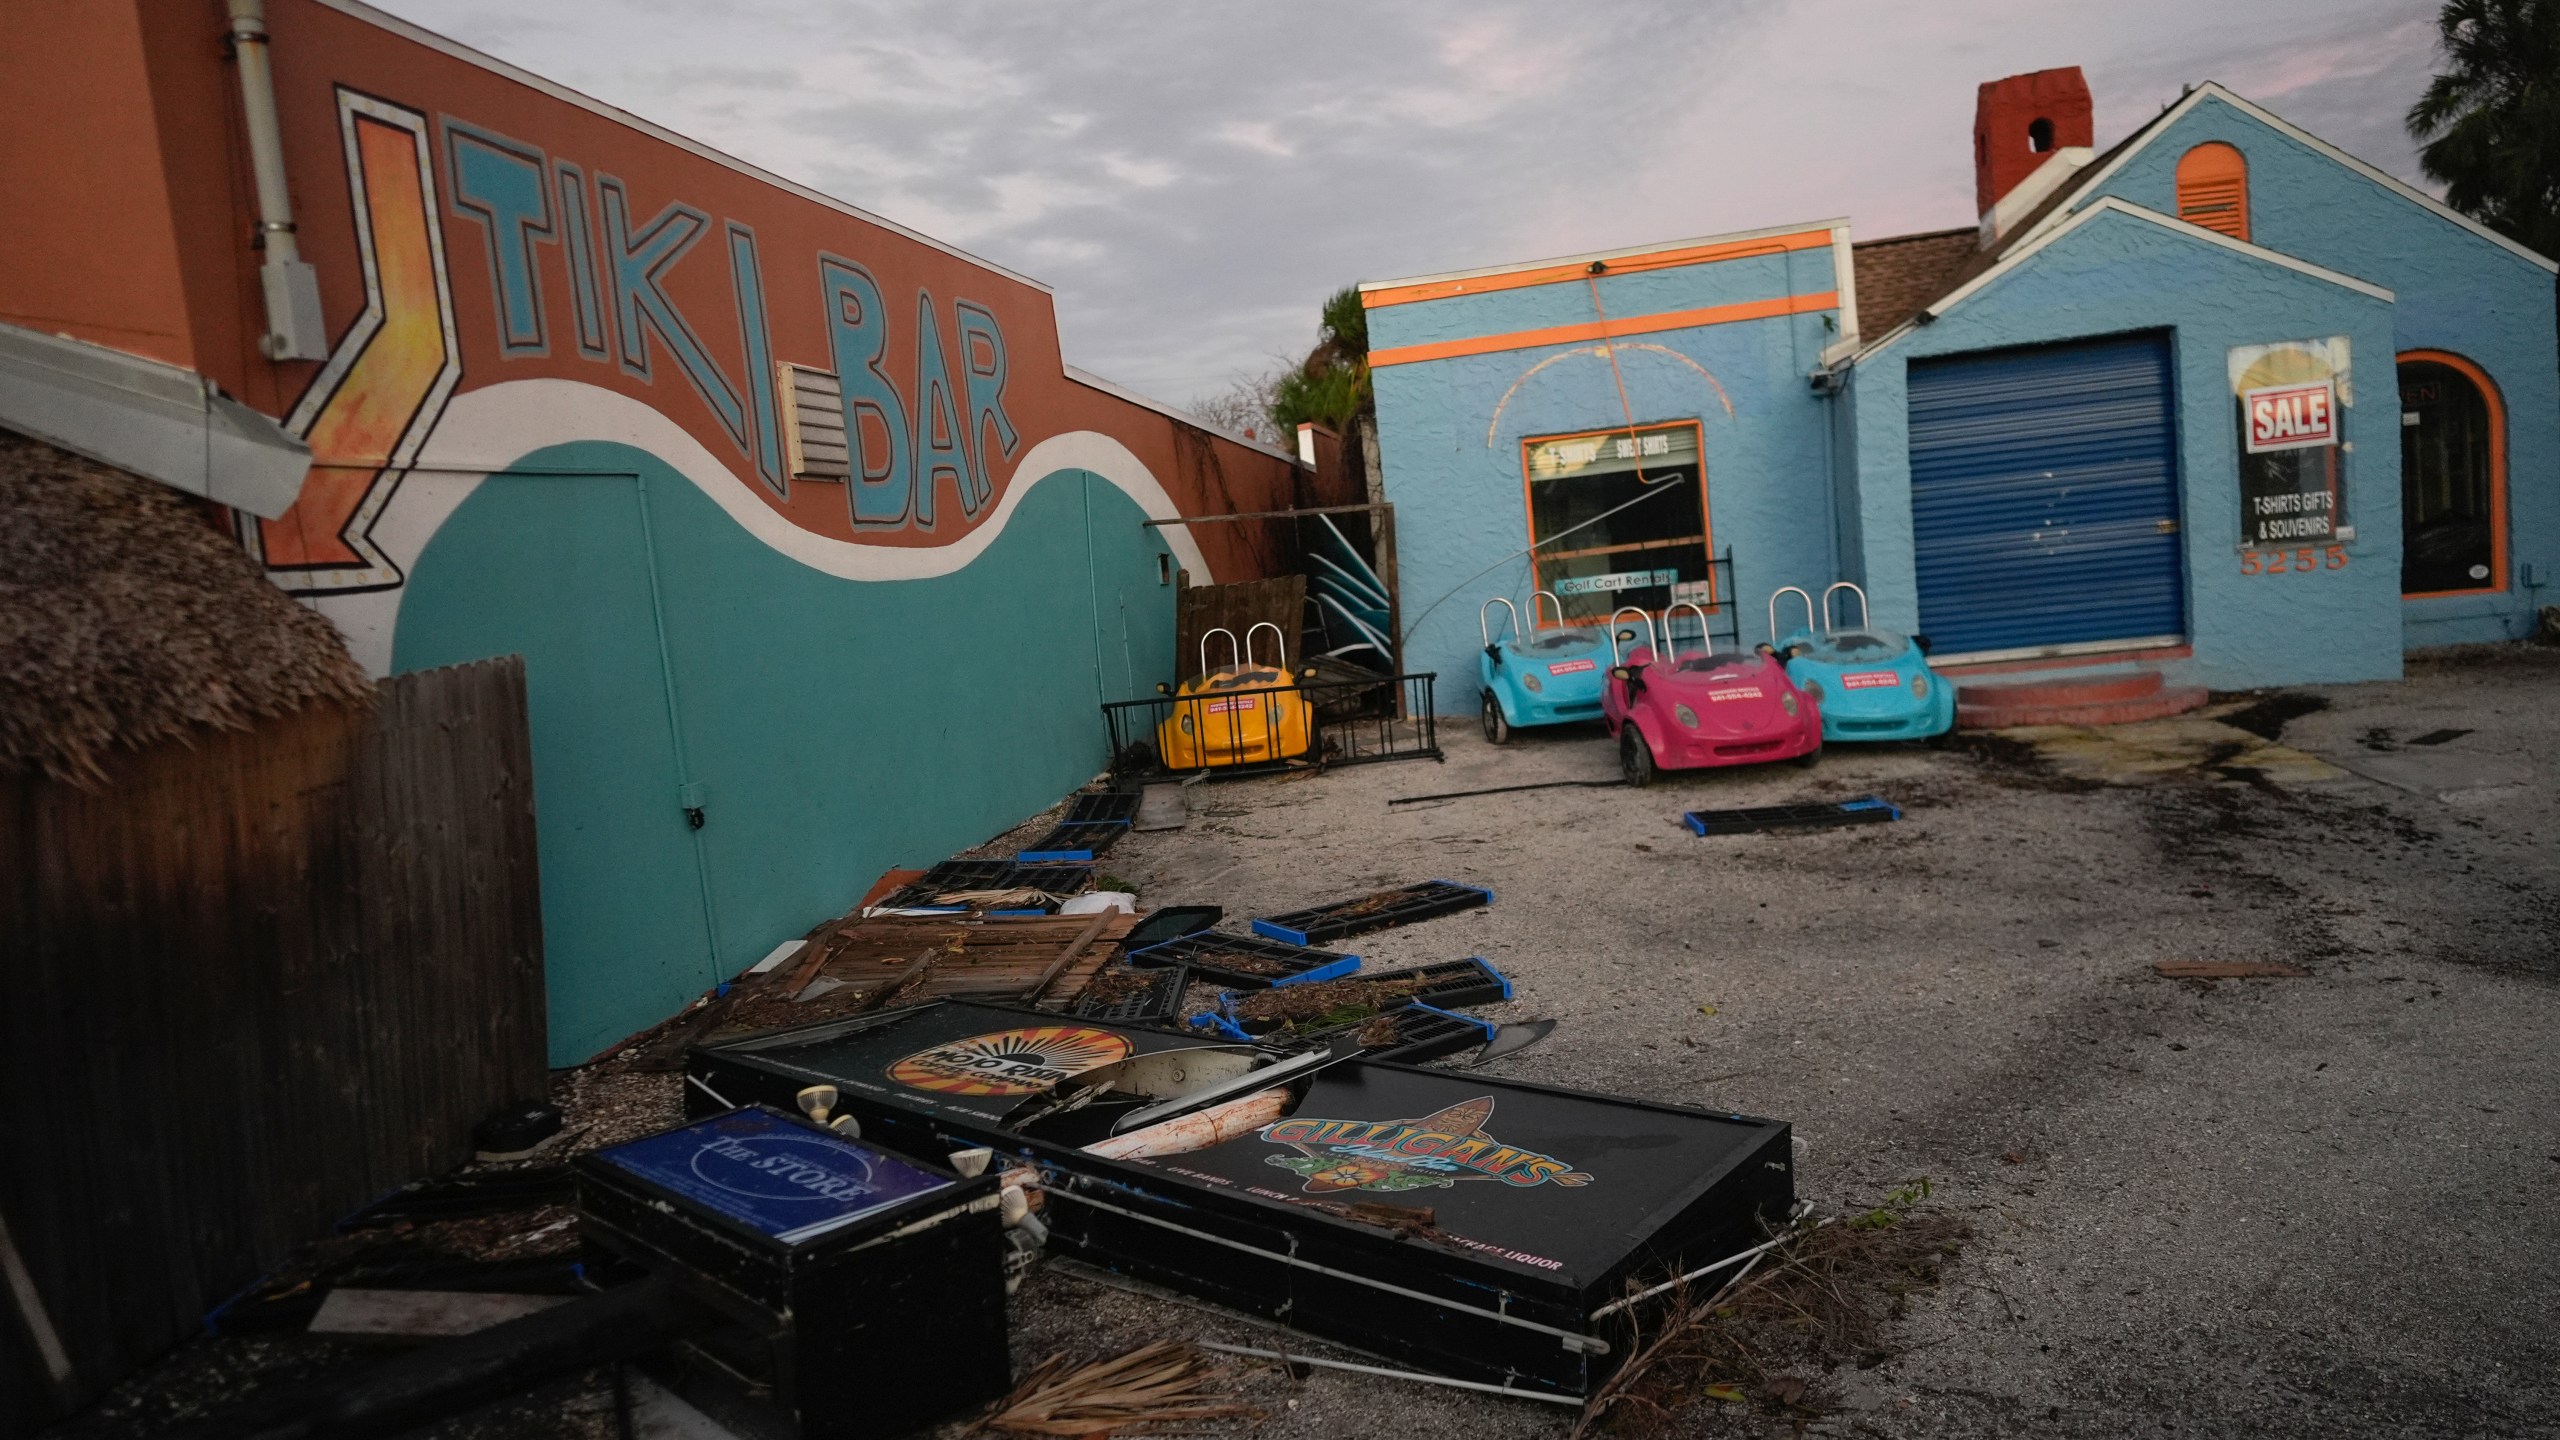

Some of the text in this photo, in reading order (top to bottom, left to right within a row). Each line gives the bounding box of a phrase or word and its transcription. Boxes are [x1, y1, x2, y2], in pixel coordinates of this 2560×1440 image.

[441, 113, 1020, 533] TIKI BAR
[2255, 393, 2328, 440] SALE
[2253, 490, 2334, 515] T-SHIRTS GIFTS
[2258, 515, 2330, 540] & SOUVENIRS
[2240, 544, 2349, 576] 5255
[1564, 580, 1591, 592] Golf
[1594, 577, 1622, 589] Cart
[910, 1059, 971, 1074] COFFEE
[970, 1071, 1044, 1088] COMPANY
[921, 1050, 1004, 1068] MOJO
[1263, 1118, 1571, 1186] GILLIGAN'S
[748, 1156, 873, 1202] STORE
[1166, 1166, 1196, 1176] LIVE
[1191, 1173, 1234, 1186] BANDS
[1245, 1186, 1289, 1200] LUNCH
[1503, 1250, 1564, 1271] LIQUOR
